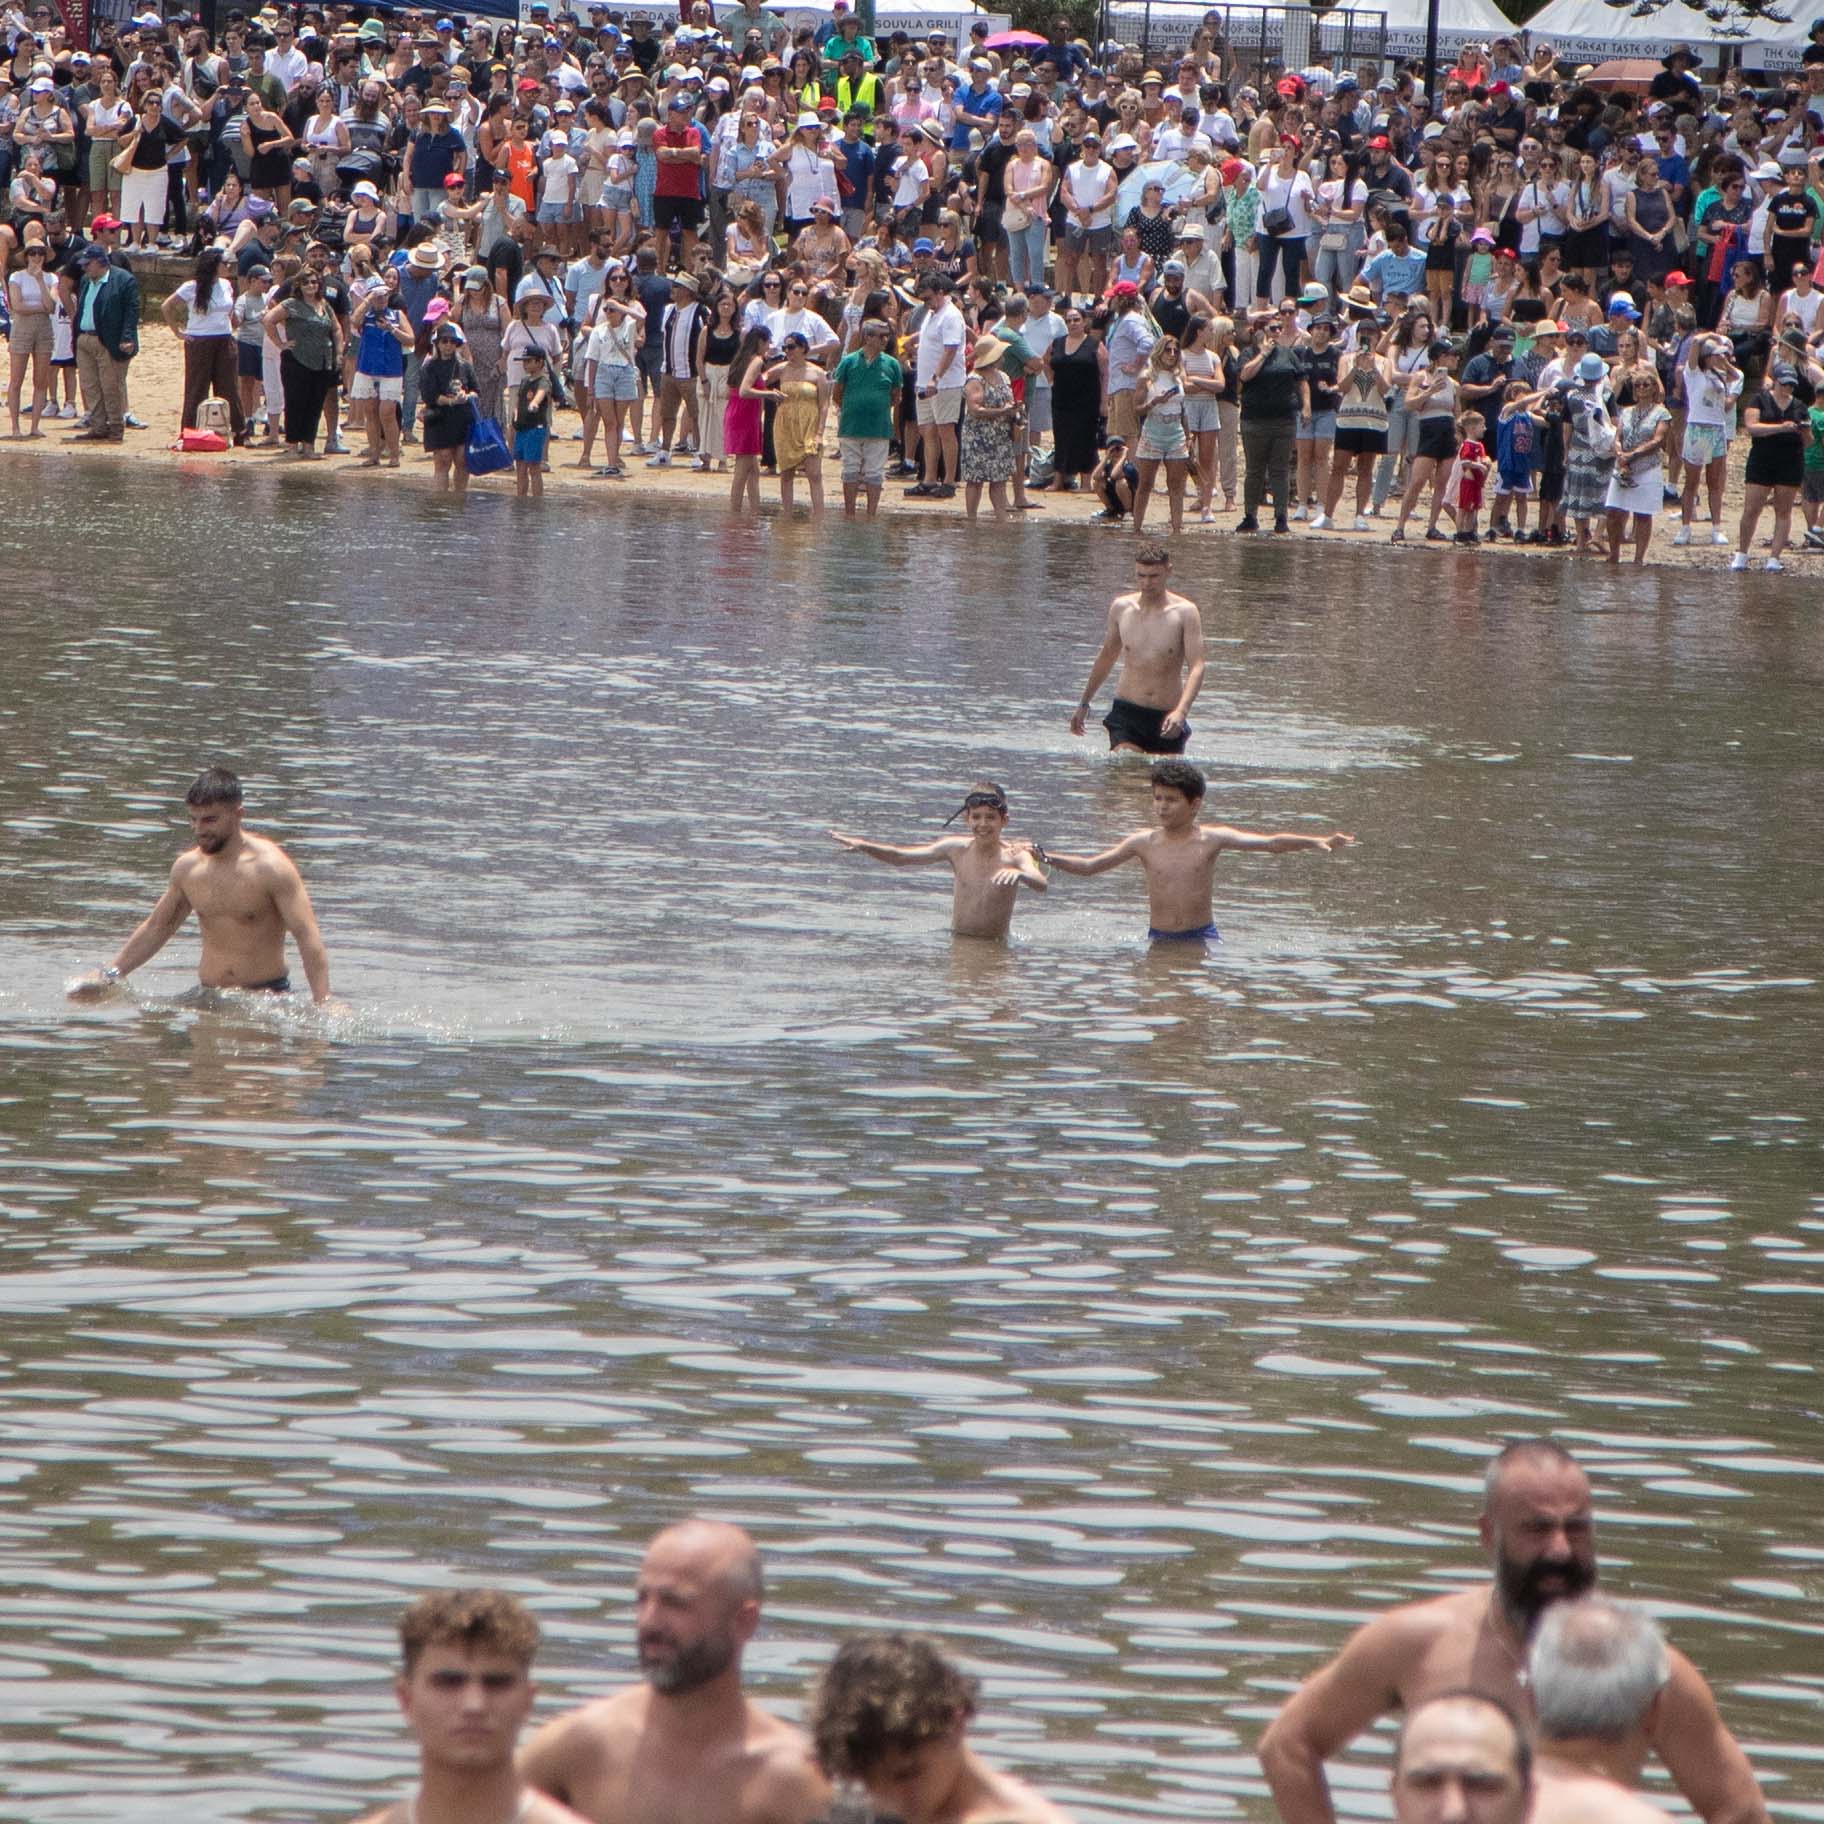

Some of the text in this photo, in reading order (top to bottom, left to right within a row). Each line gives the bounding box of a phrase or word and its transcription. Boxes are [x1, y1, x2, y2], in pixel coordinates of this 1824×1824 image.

[875, 18, 923, 29] SOUVLA
[1553, 39, 1573, 50] THE
[1576, 40, 1607, 52] GREAT
[1611, 42, 1640, 55] TASTE
[1643, 44, 1656, 55] OF
[1763, 47, 1783, 59] THE
